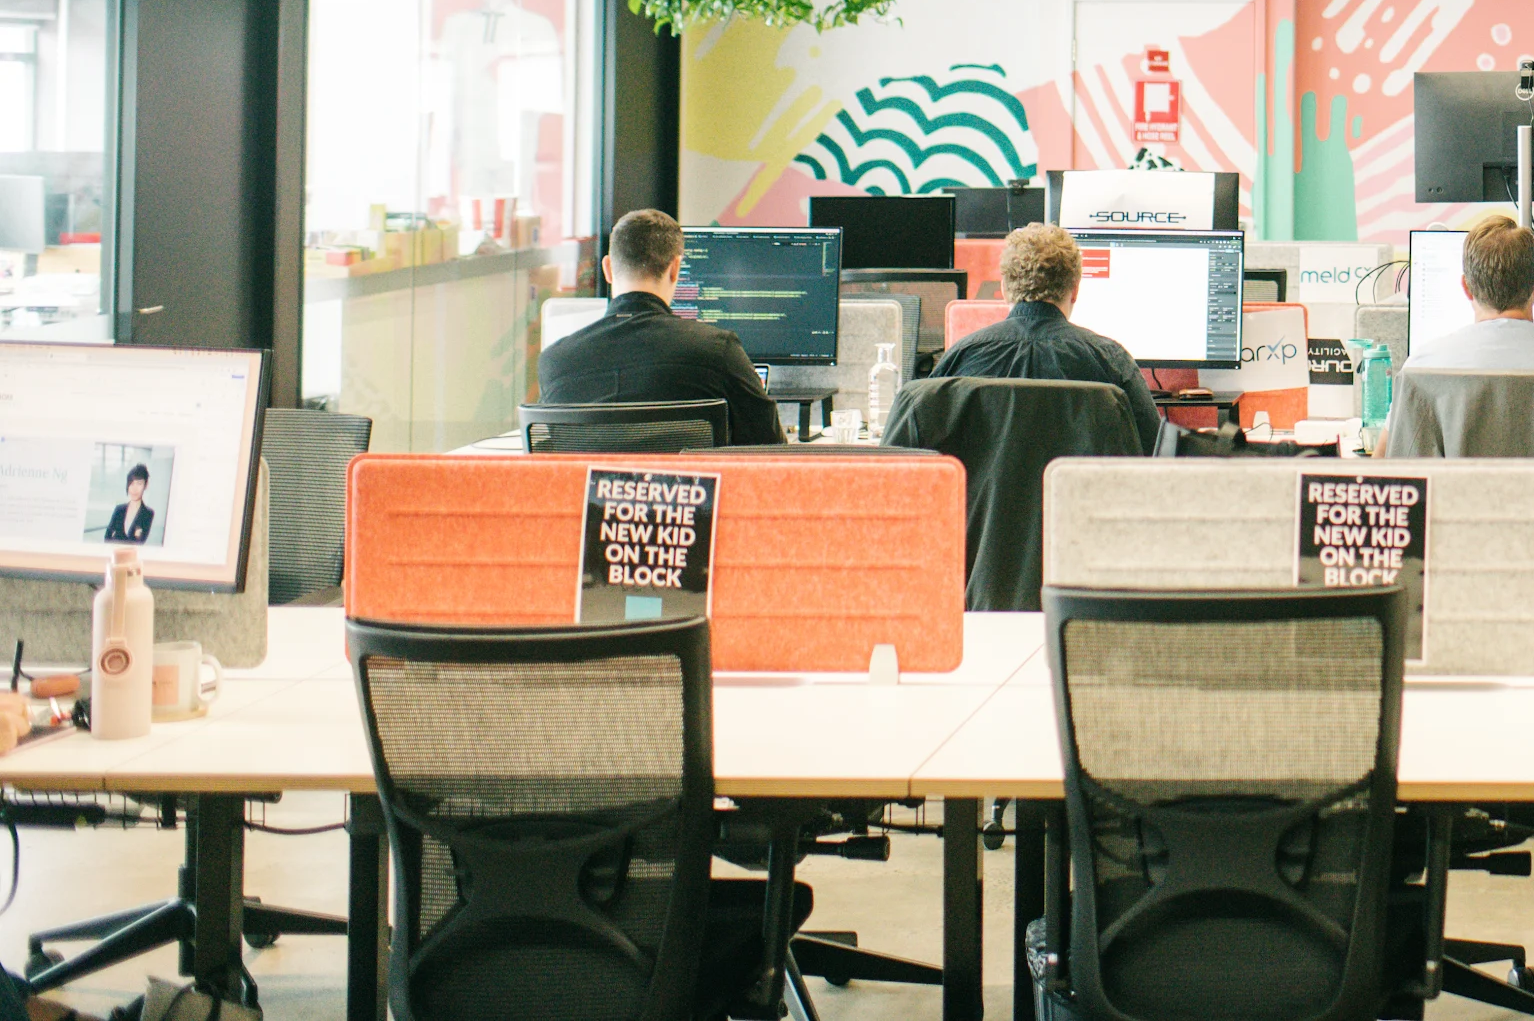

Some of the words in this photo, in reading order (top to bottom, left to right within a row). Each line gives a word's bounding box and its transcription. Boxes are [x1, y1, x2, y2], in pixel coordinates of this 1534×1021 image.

[1095, 211, 1180, 224] SOURCE
[597, 479, 706, 505] RESERVED
[1308, 482, 1419, 506] RESERVED
[604, 501, 648, 523] FOR
[652, 504, 696, 526] THE
[1316, 504, 1362, 525] FOR
[1365, 505, 1410, 527] THE
[600, 522, 653, 544] NEW
[656, 526, 696, 547] KID
[1314, 525, 1367, 546] NEW
[1371, 527, 1411, 548] KID
[605, 543, 640, 564] ON
[645, 546, 688, 568] THE
[1319, 546, 1356, 566] ON
[1359, 547, 1404, 569] THE
[608, 564, 682, 588] BLOCK
[1324, 567, 1399, 587] BLOCK
